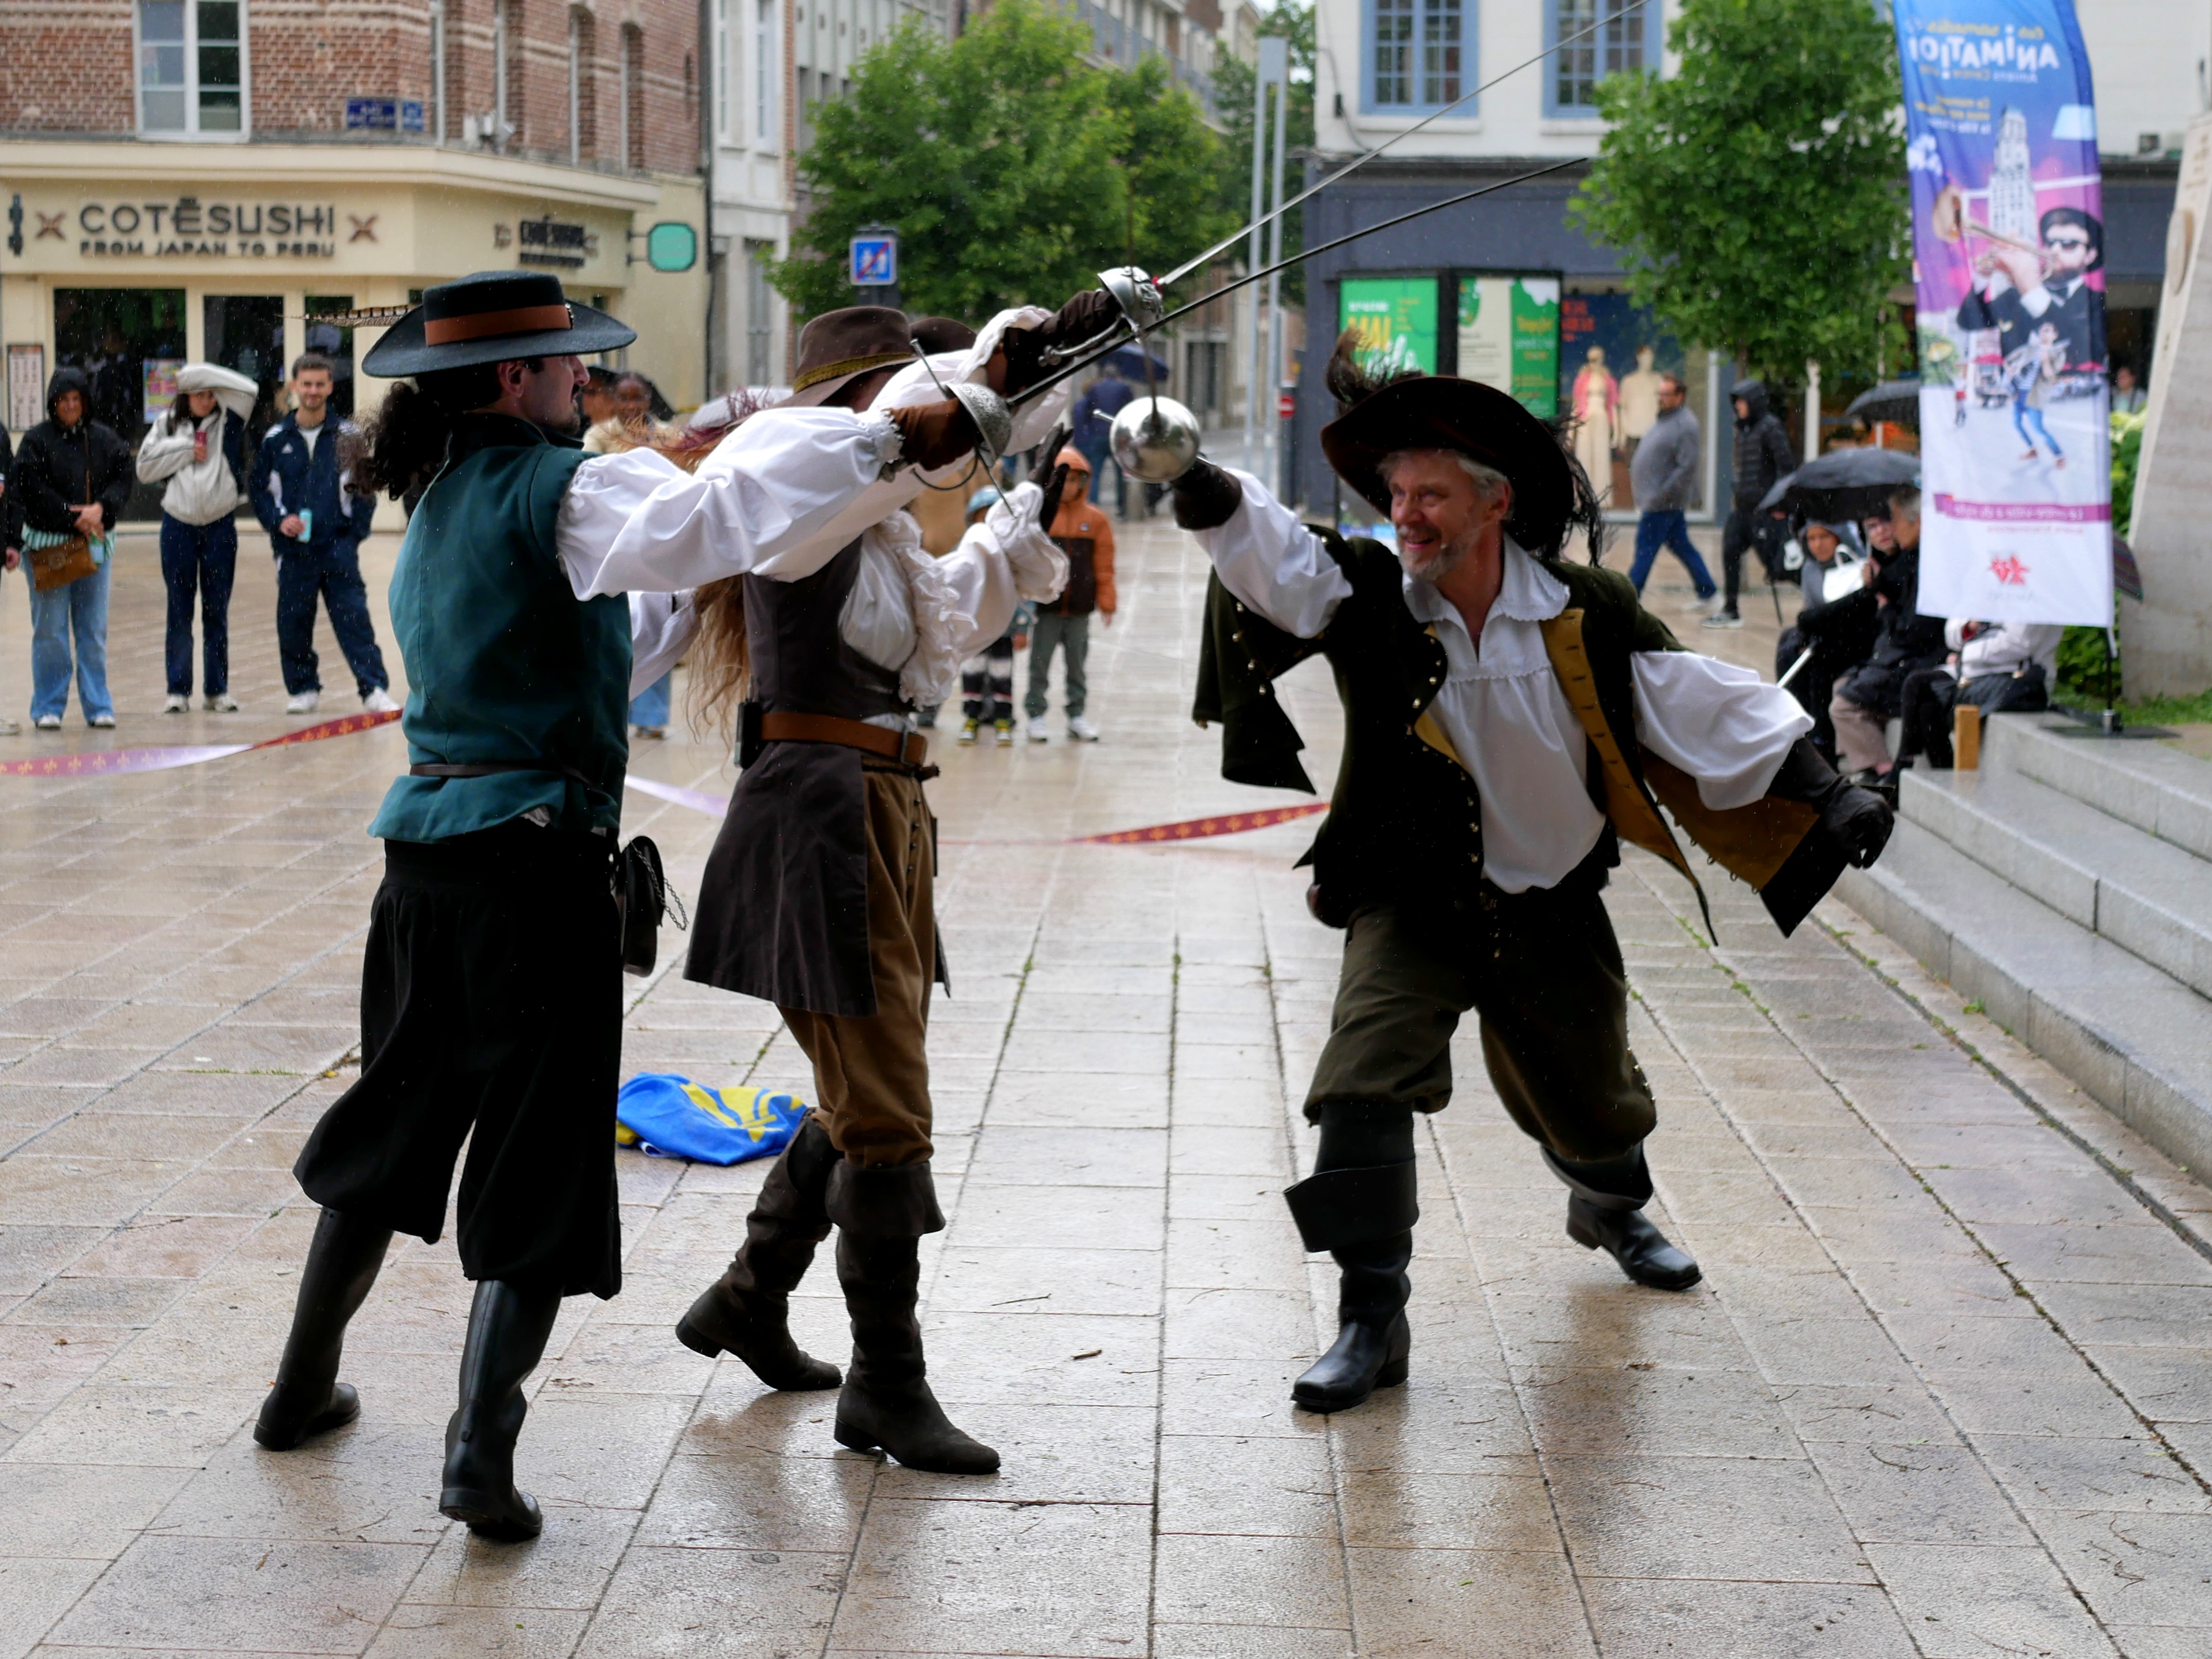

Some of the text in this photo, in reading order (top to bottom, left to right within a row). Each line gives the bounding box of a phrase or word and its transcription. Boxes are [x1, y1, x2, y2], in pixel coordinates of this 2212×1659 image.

[80, 240, 335, 257] FROM JAPAN TO PERU
